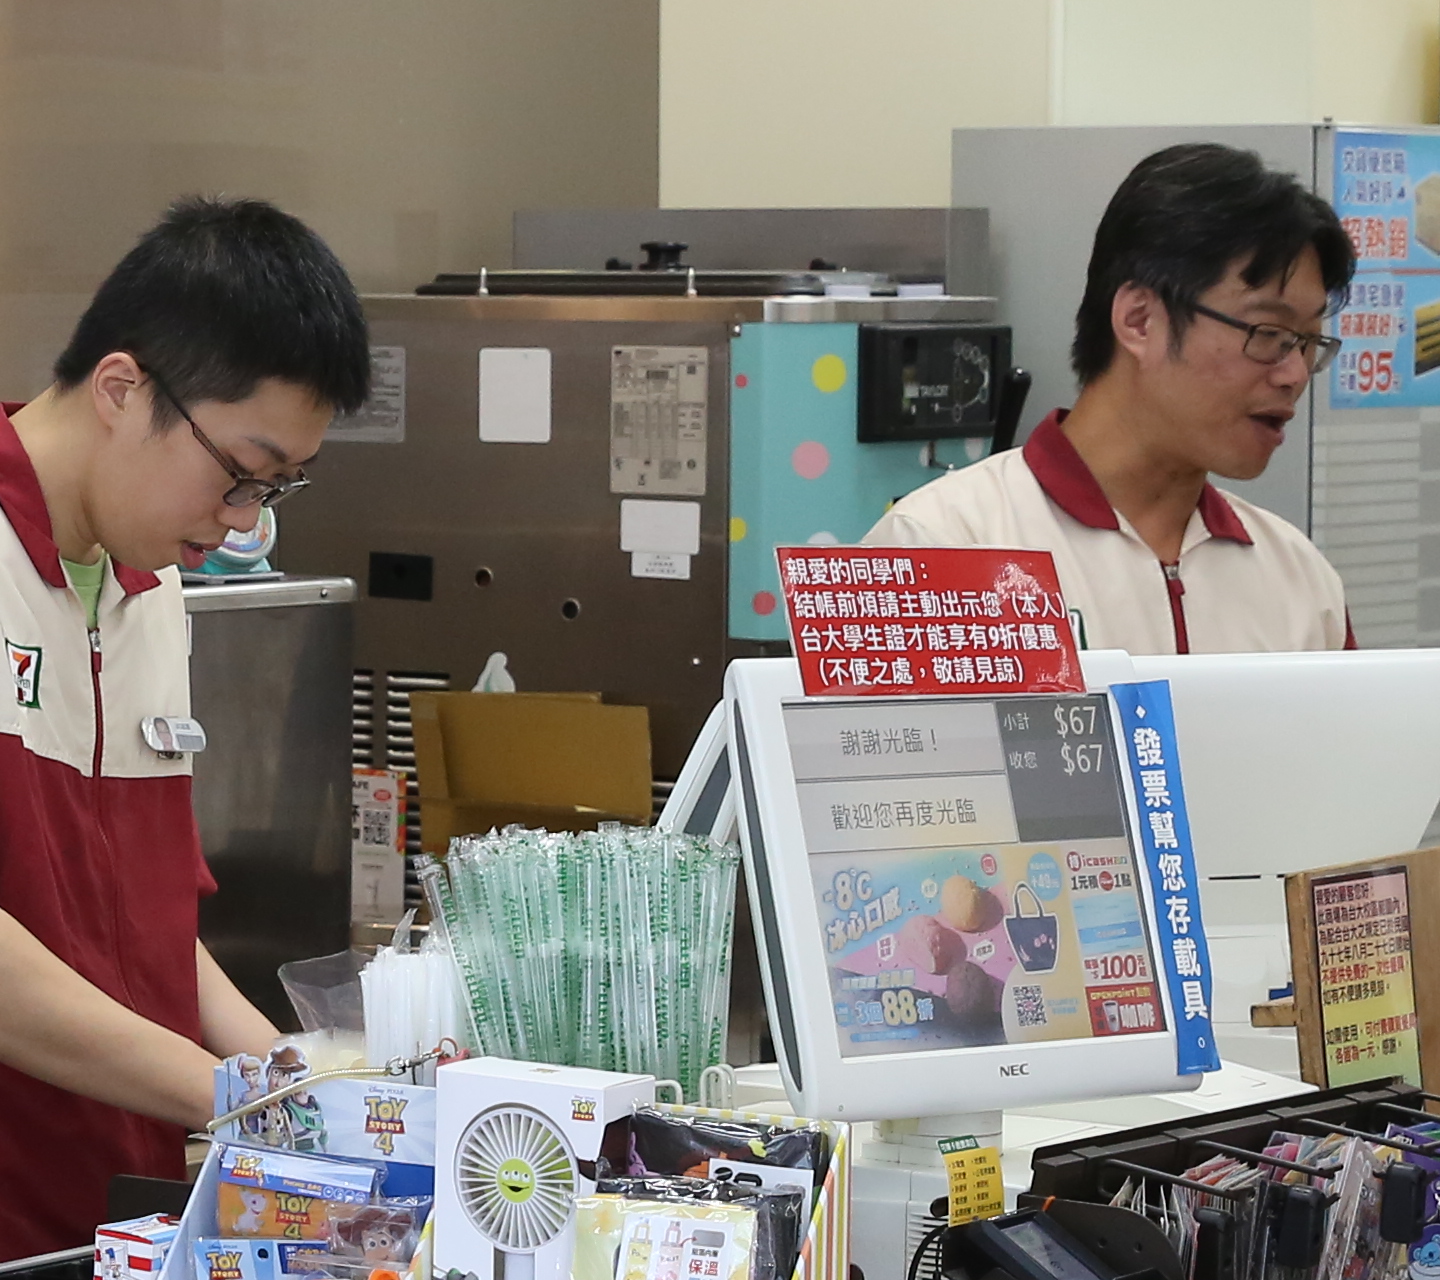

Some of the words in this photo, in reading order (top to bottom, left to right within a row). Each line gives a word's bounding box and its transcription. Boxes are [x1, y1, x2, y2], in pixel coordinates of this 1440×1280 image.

[1358, 350, 1393, 394] 95
[786, 558, 929, 587] 親愛的同學們：
[799, 624, 1058, 655] 台大學生證才能享有9折優惠
[1004, 712, 1030, 731] 小計
[1056, 706, 1097, 738] $67
[1010, 751, 1038, 770] 收您
[1062, 743, 1103, 776] $67
[831, 797, 977, 833] 歡迎您再度光臨
[1133, 726, 1210, 1021] 發票幫您存載具
[1100, 953, 1138, 980] 100
[999, 1063, 1030, 1078] NEC
[364, 1095, 409, 1121] TOY
[366, 1120, 405, 1134] STORY
[374, 1132, 395, 1155] 4
[276, 1193, 314, 1215] TOY
[276, 1211, 311, 1225] STORY
[207, 1252, 243, 1272] TOY
[209, 1269, 243, 1280] STORY
[688, 1258, 719, 1278] 保溫
